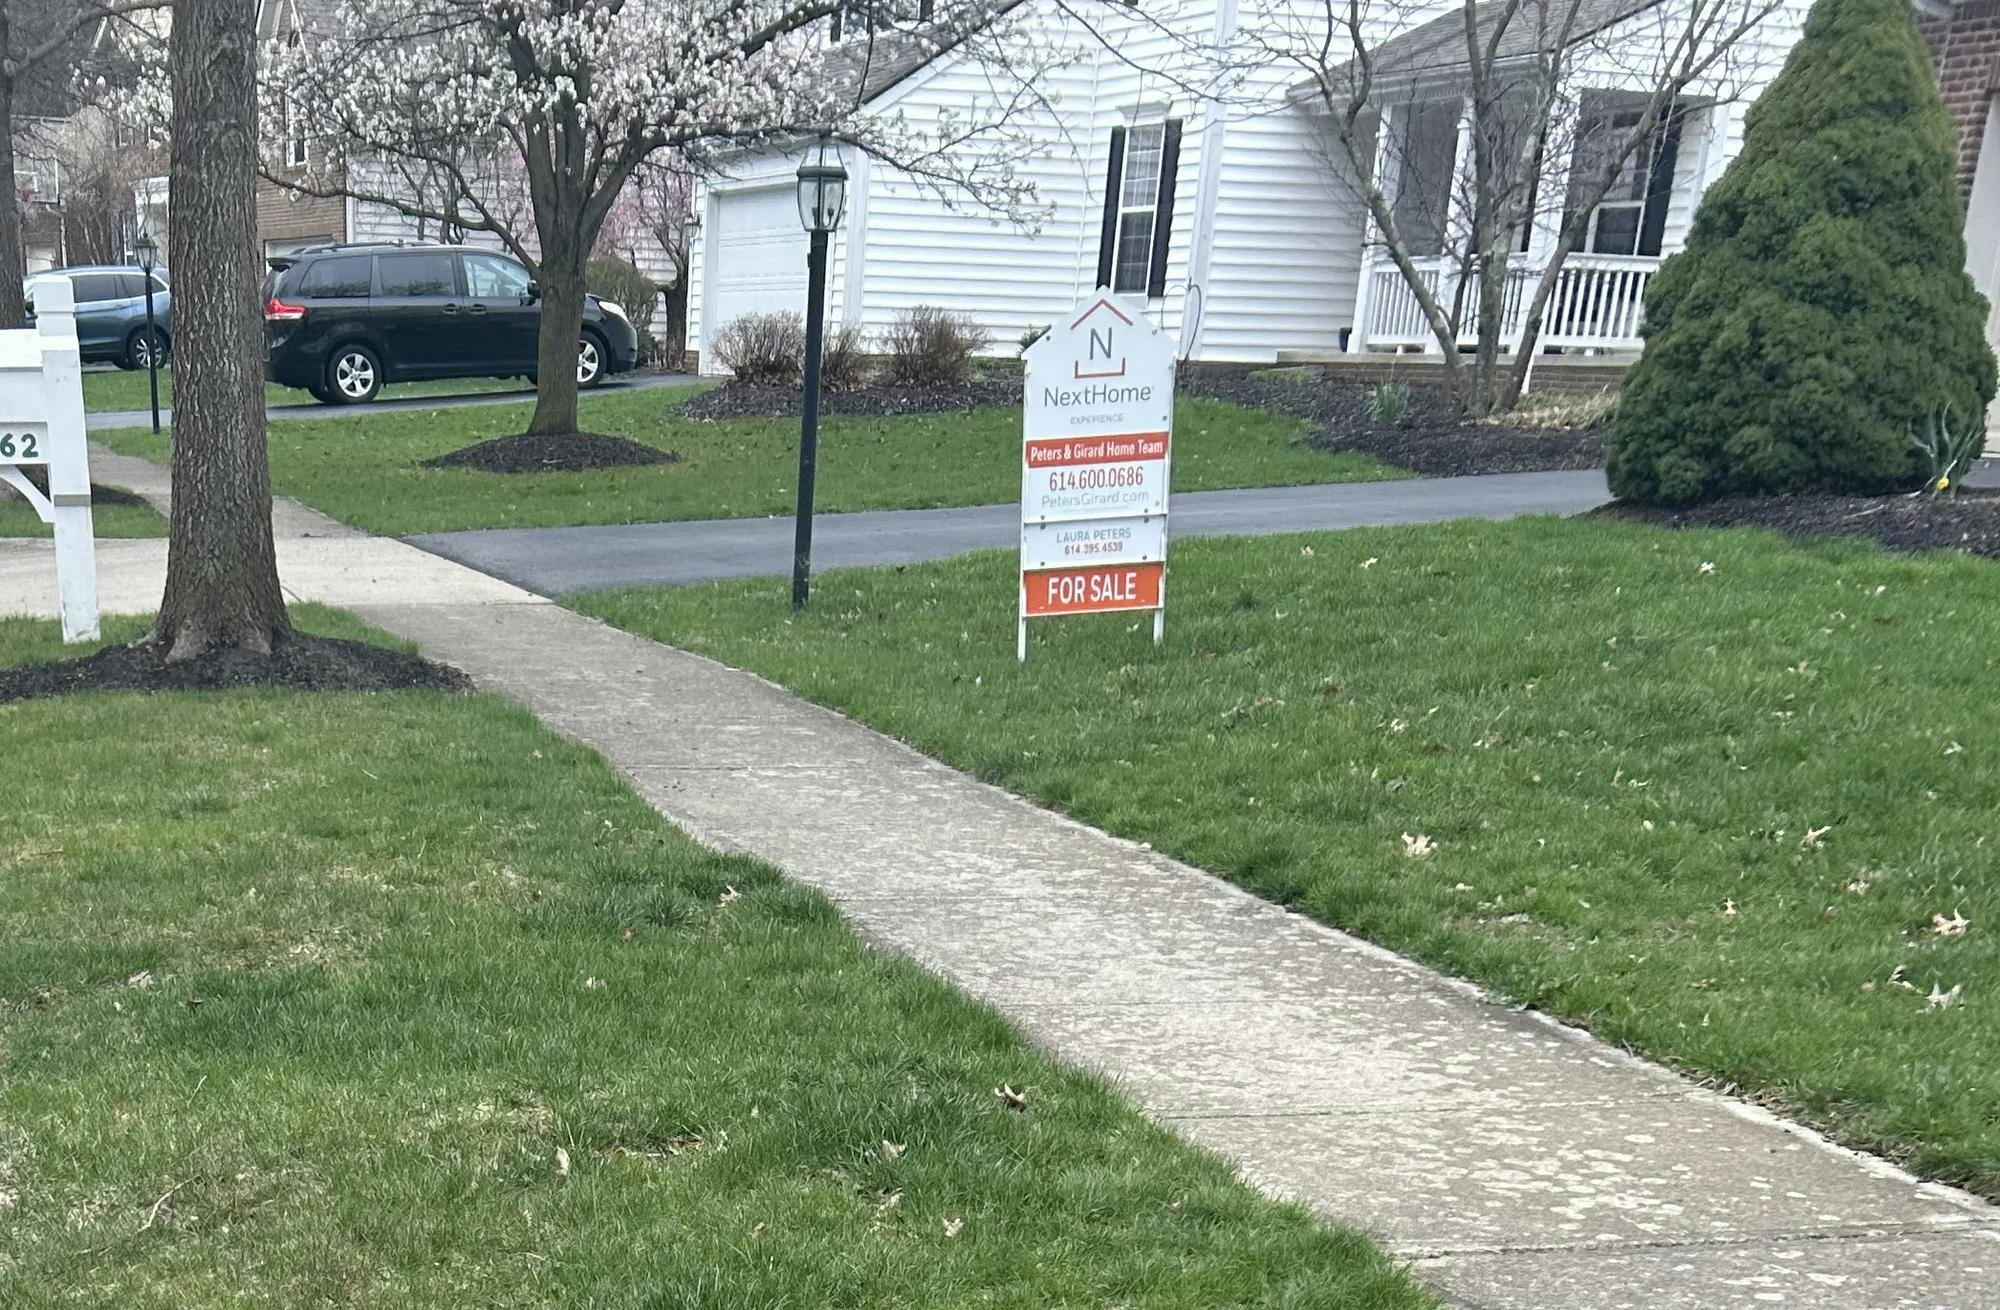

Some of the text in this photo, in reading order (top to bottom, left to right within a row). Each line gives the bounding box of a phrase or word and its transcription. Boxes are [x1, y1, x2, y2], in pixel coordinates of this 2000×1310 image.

[1089, 326, 1113, 360] N
[1044, 383, 1151, 407] NextHome
[1070, 412, 1124, 425] EXPERIENCE
[0, 433, 39, 458] 62
[1030, 439, 1163, 462] Peters & Girard Home Team
[1049, 465, 1144, 492] 614.600.0686
[1041, 490, 1149, 508] PetersGirard.com
[1056, 527, 1132, 544] LAURA PETERS
[1048, 572, 1137, 606] FOR SALE
